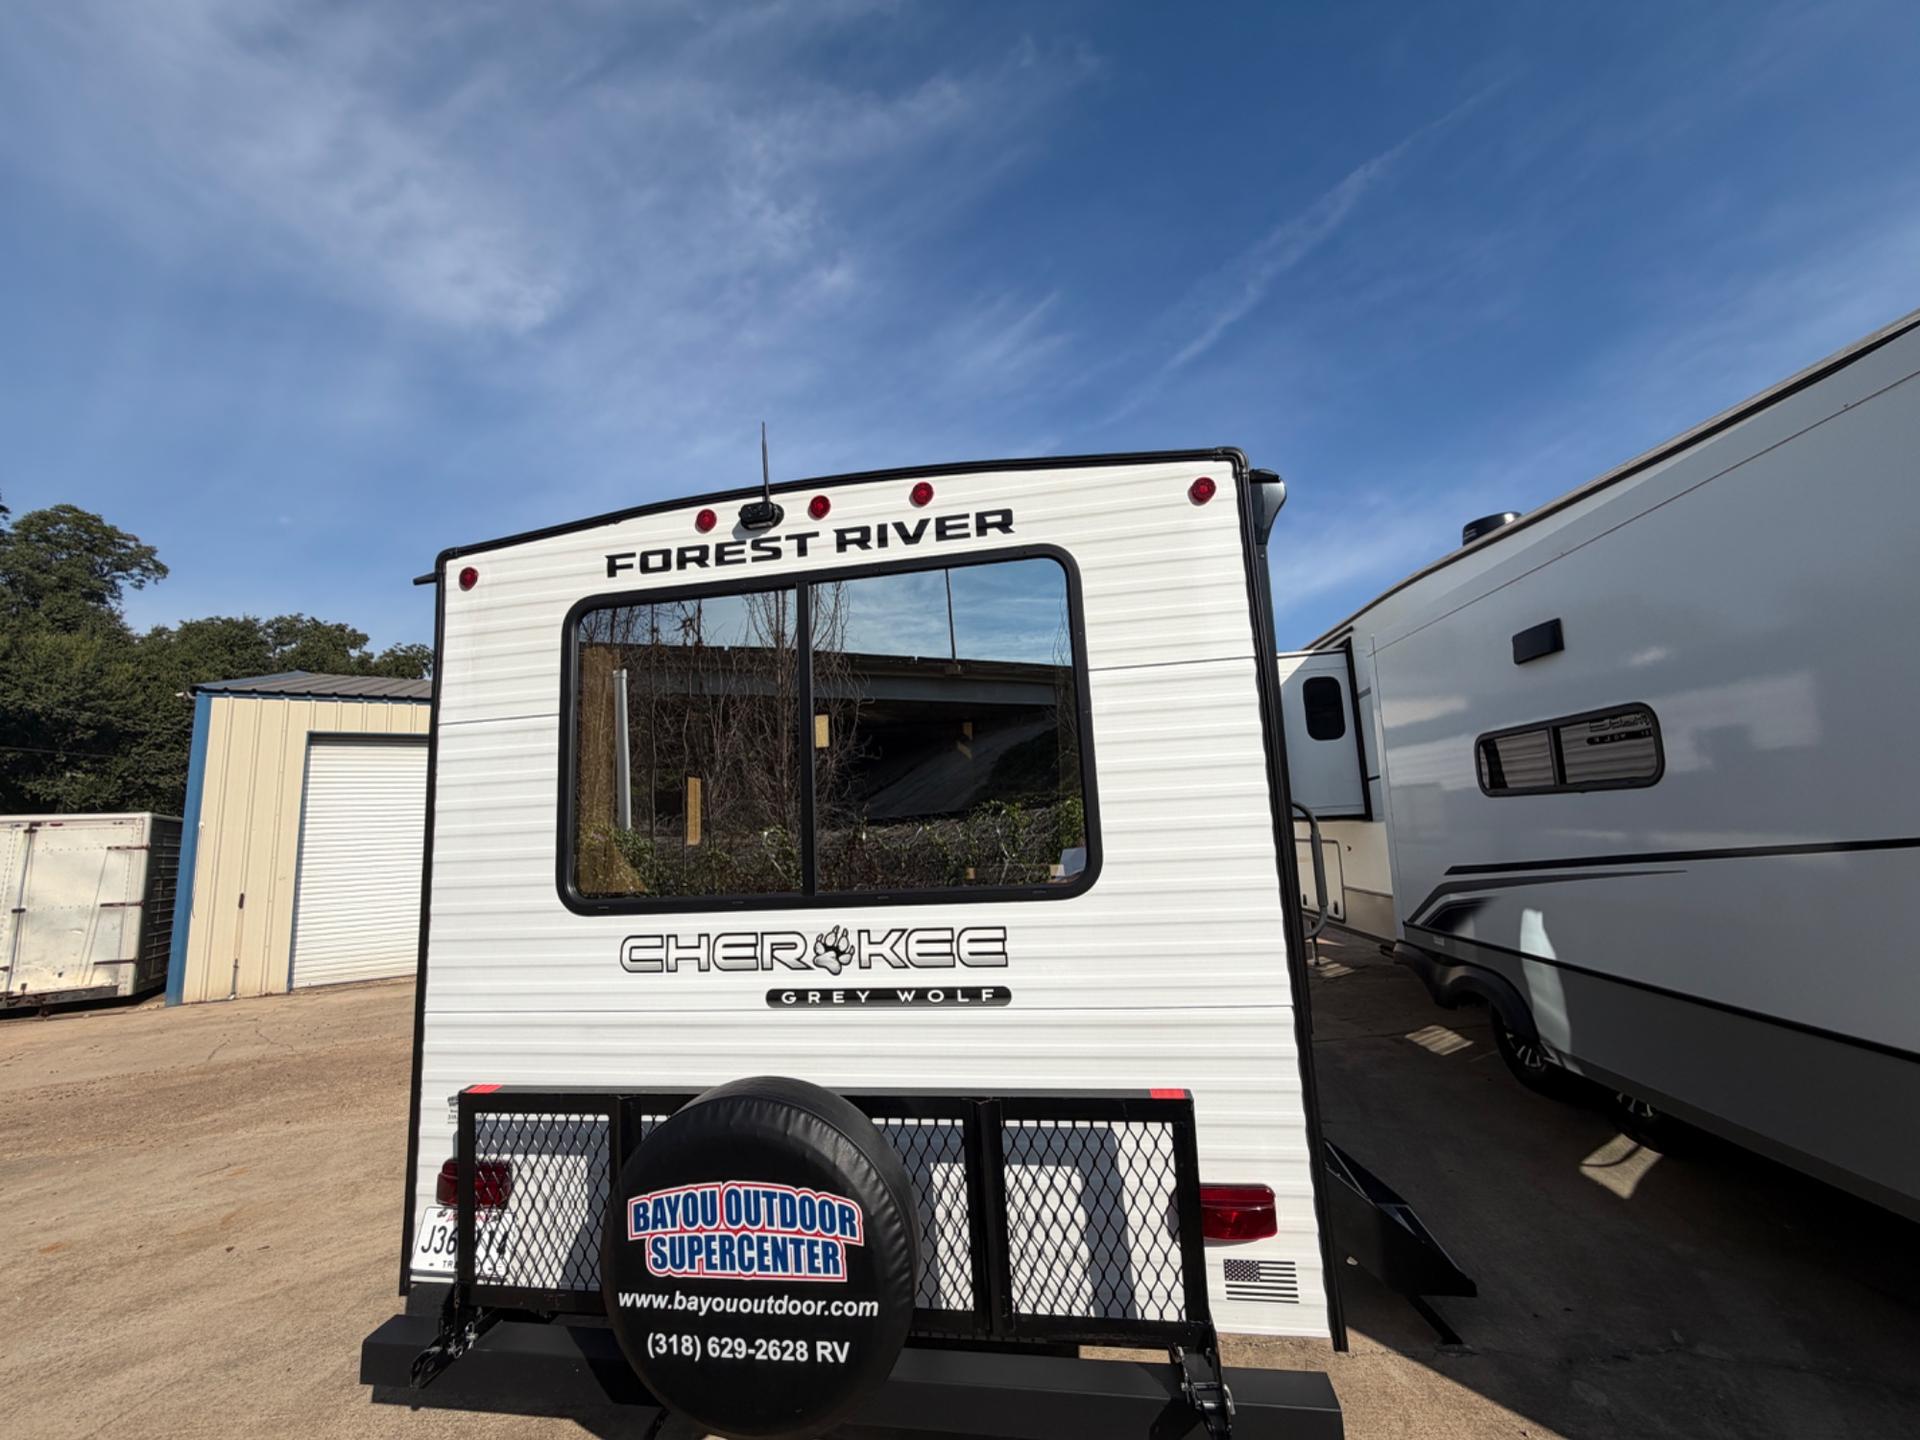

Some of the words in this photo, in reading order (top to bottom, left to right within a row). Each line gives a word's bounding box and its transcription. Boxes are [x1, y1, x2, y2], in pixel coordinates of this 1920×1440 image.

[604, 530, 820, 578] FOREST
[833, 508, 1016, 553] RIVER
[781, 990, 871, 1004] GREY
[897, 988, 995, 1003] WOLF
[632, 1188, 719, 1233] BAYOU
[723, 1187, 858, 1239] OUTDOOR
[650, 1233, 842, 1275] SUPERCENTER
[618, 1290, 879, 1317] www.bayououtdoor.com
[647, 1332, 701, 1361] (318)
[707, 1336, 809, 1362] 629-2628
[816, 1341, 850, 1363] RV
